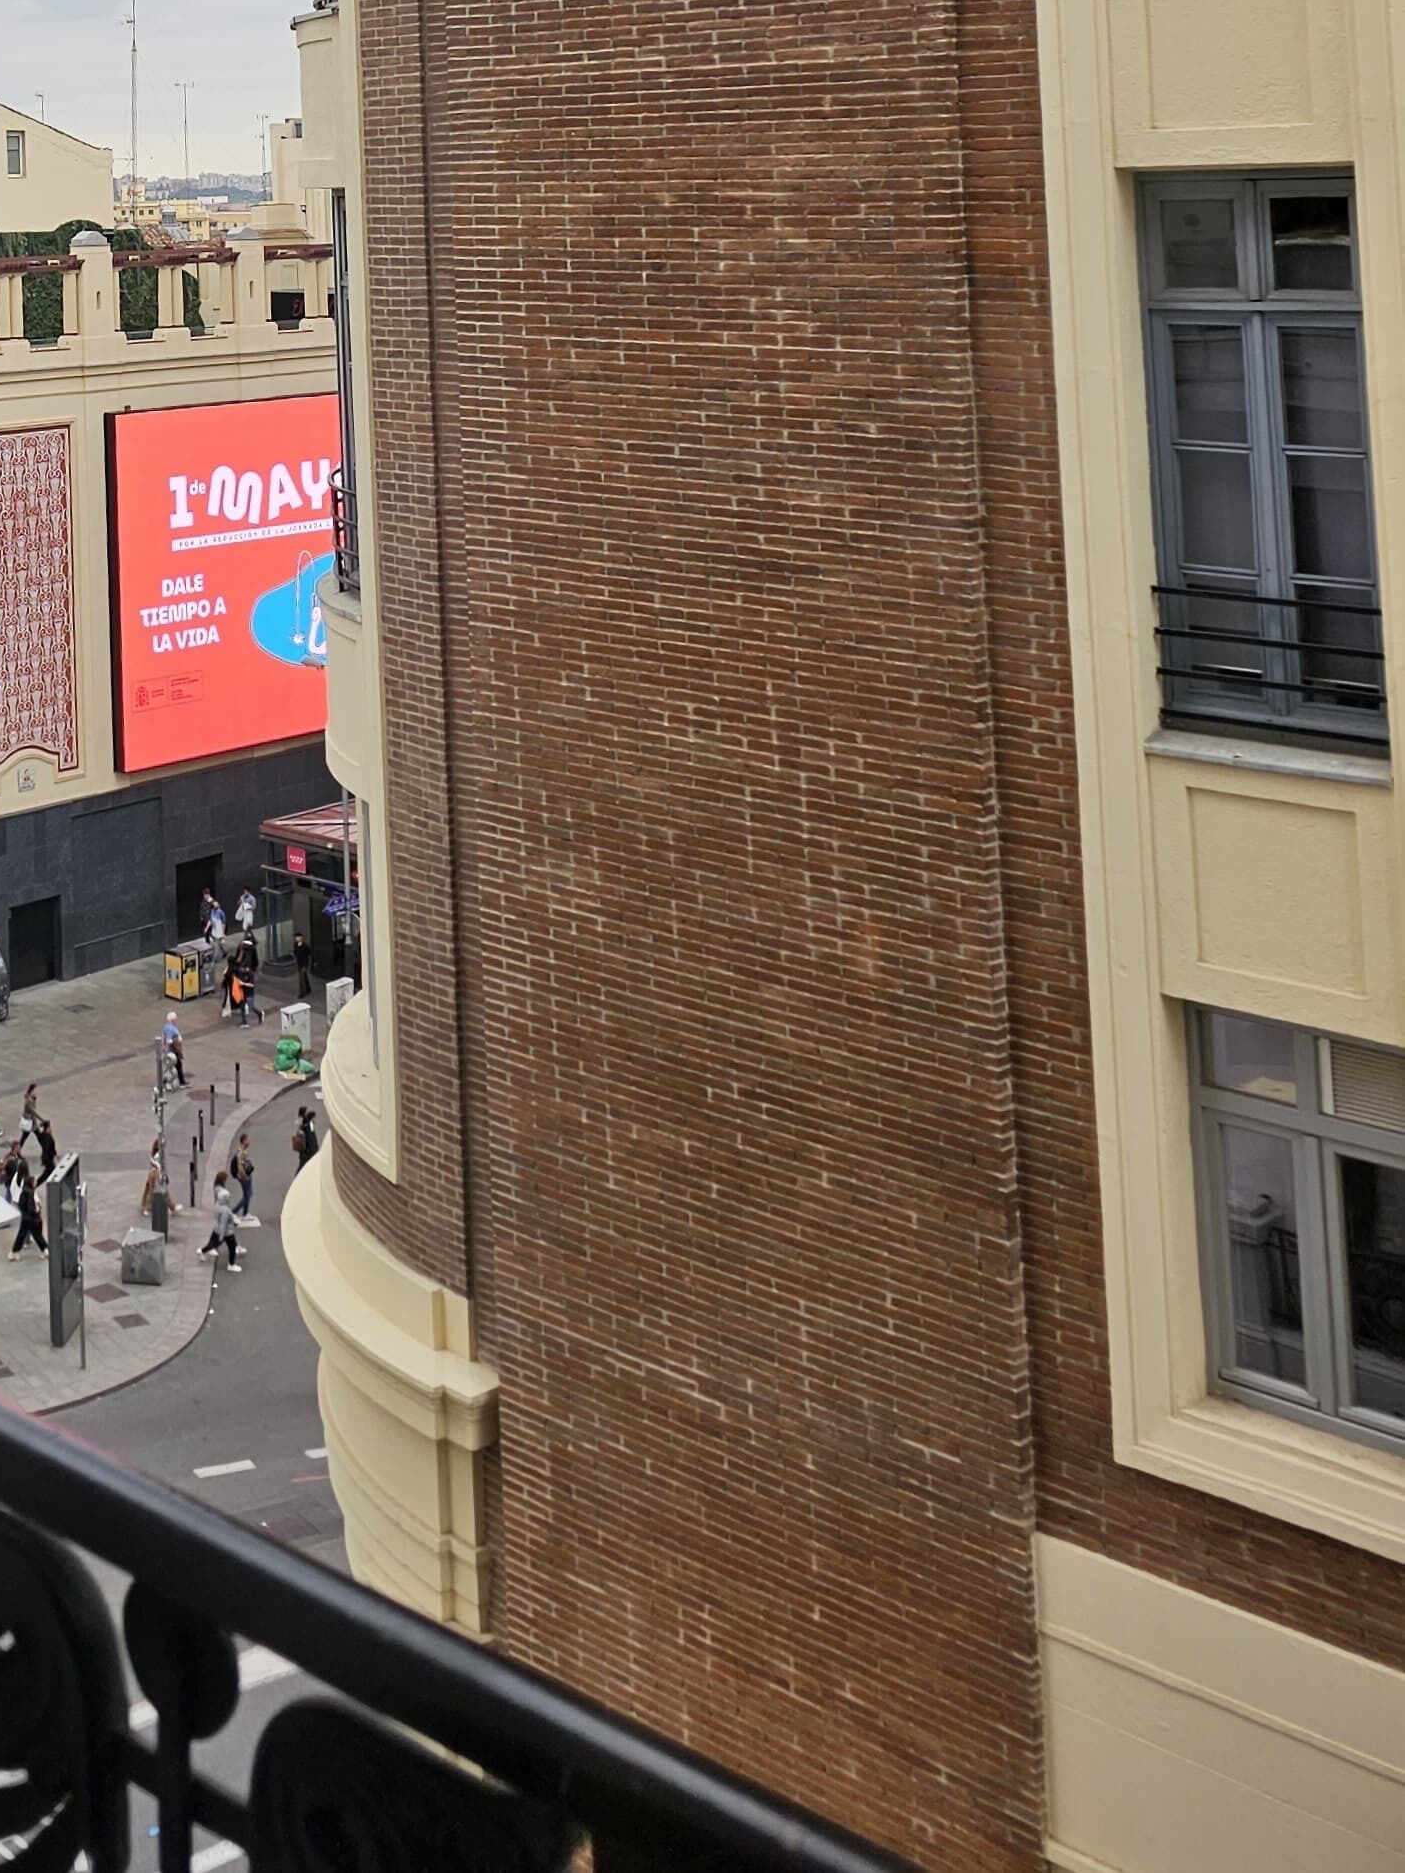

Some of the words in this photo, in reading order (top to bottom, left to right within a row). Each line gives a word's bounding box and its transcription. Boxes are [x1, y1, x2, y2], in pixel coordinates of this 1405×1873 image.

[189, 479, 206, 496] de
[161, 573, 204, 598] DALE
[139, 598, 211, 628] TIEMPO
[213, 596, 227, 616] A
[152, 632, 173, 653] LA
[174, 624, 221, 650] VIDA
